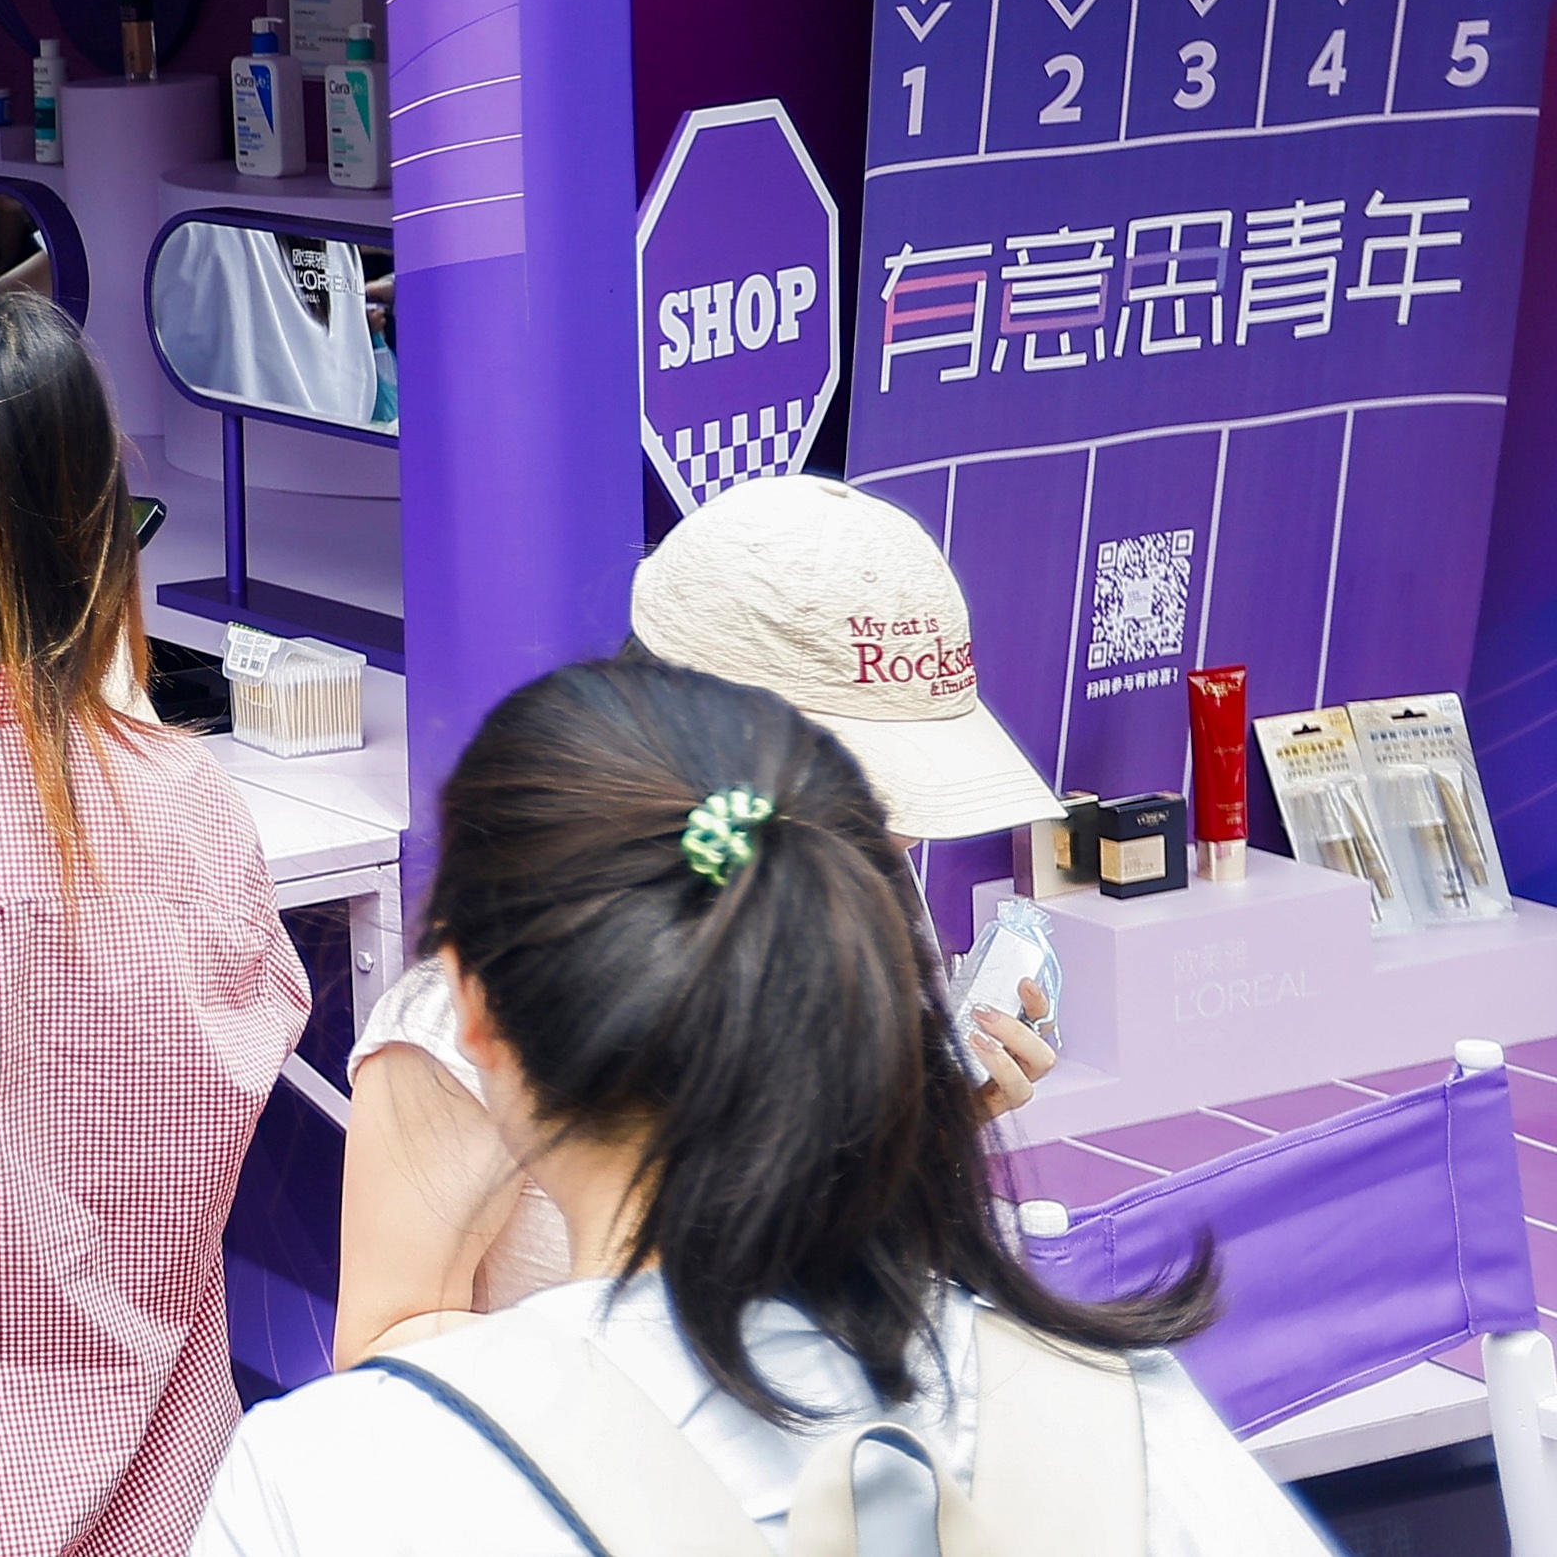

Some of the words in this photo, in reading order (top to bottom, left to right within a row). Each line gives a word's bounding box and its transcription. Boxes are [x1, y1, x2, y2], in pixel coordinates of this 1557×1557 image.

[901, 65, 927, 136] 1
[1038, 54, 1085, 125] 2
[1172, 40, 1218, 111] 3
[1307, 29, 1348, 96] 4
[1445, 20, 1490, 88] 5
[658, 266, 817, 371] SHOP
[880, 190, 1470, 393] 有意思青年
[847, 616, 887, 641] My
[891, 618, 922, 636] cat
[924, 613, 939, 634] is
